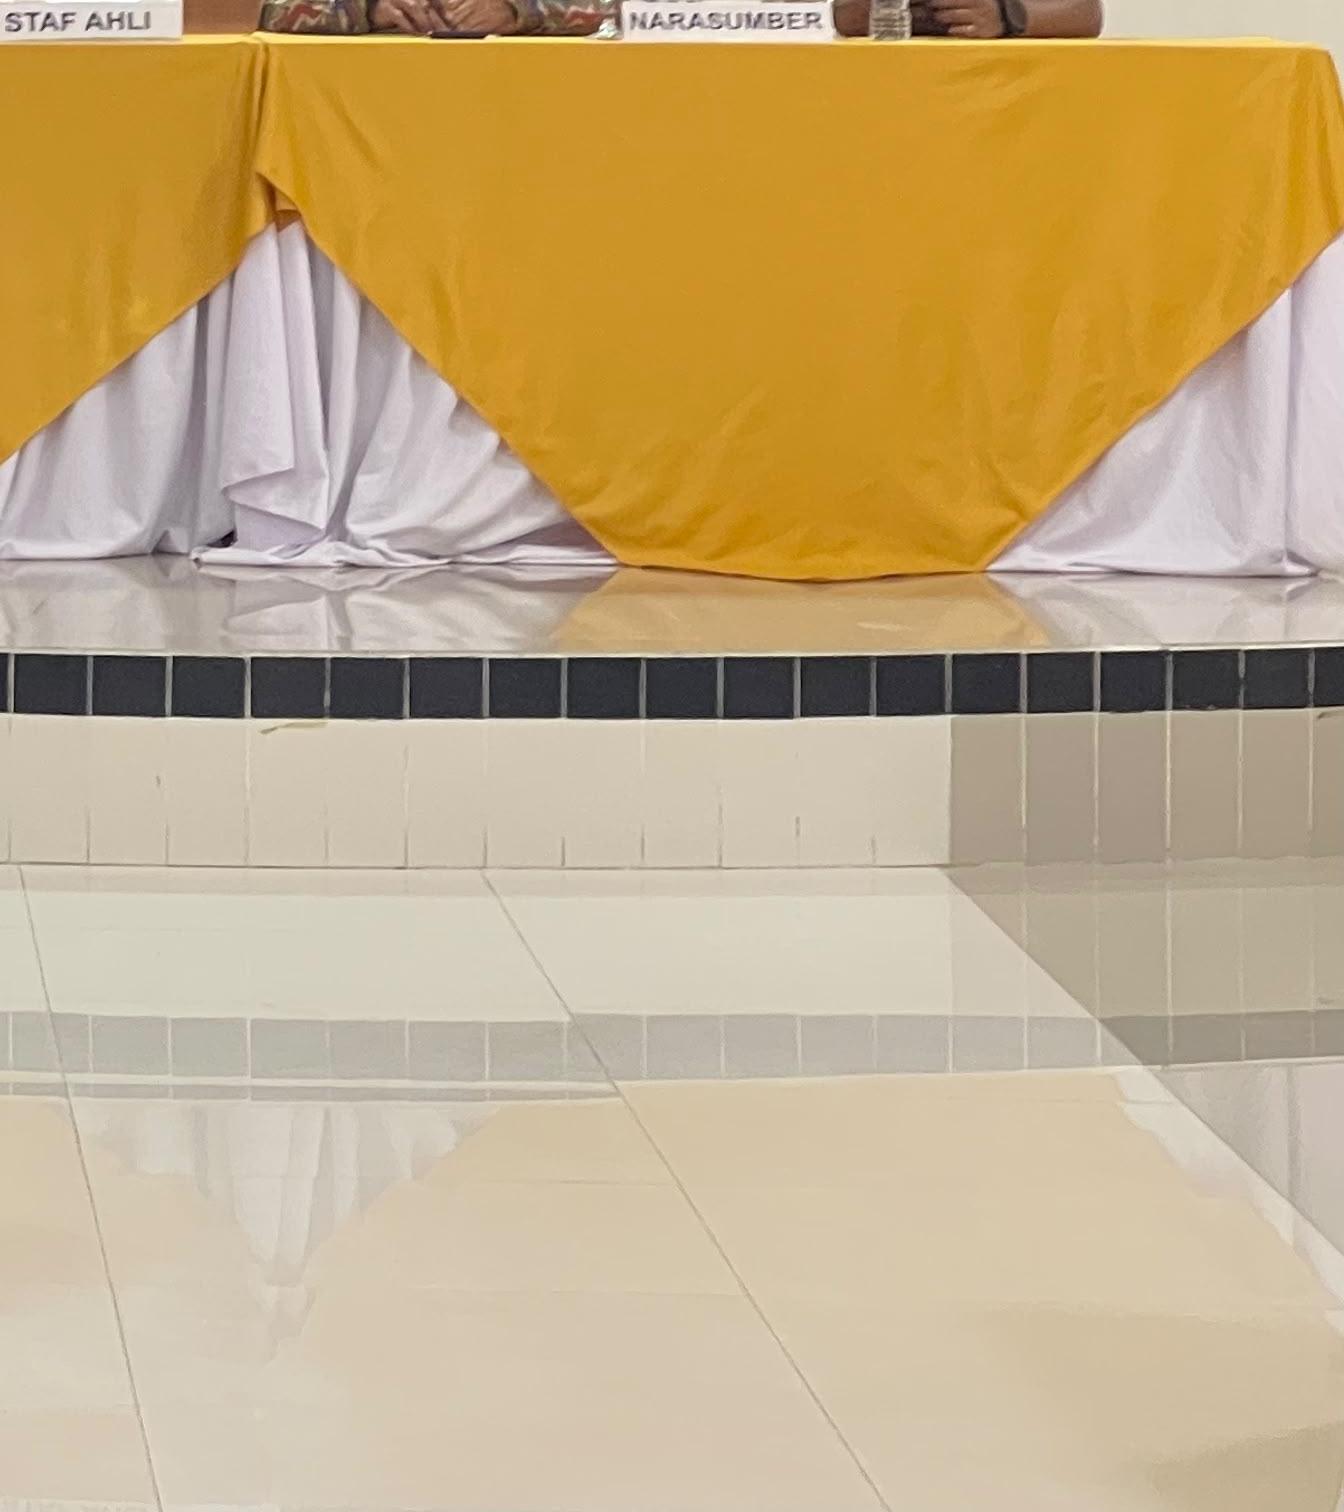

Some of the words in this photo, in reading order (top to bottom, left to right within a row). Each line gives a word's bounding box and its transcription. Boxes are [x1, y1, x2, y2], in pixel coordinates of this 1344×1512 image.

[4, 11, 77, 33] STAF
[84, 11, 151, 32] AHLI
[629, 11, 823, 31] NARASUMBER
